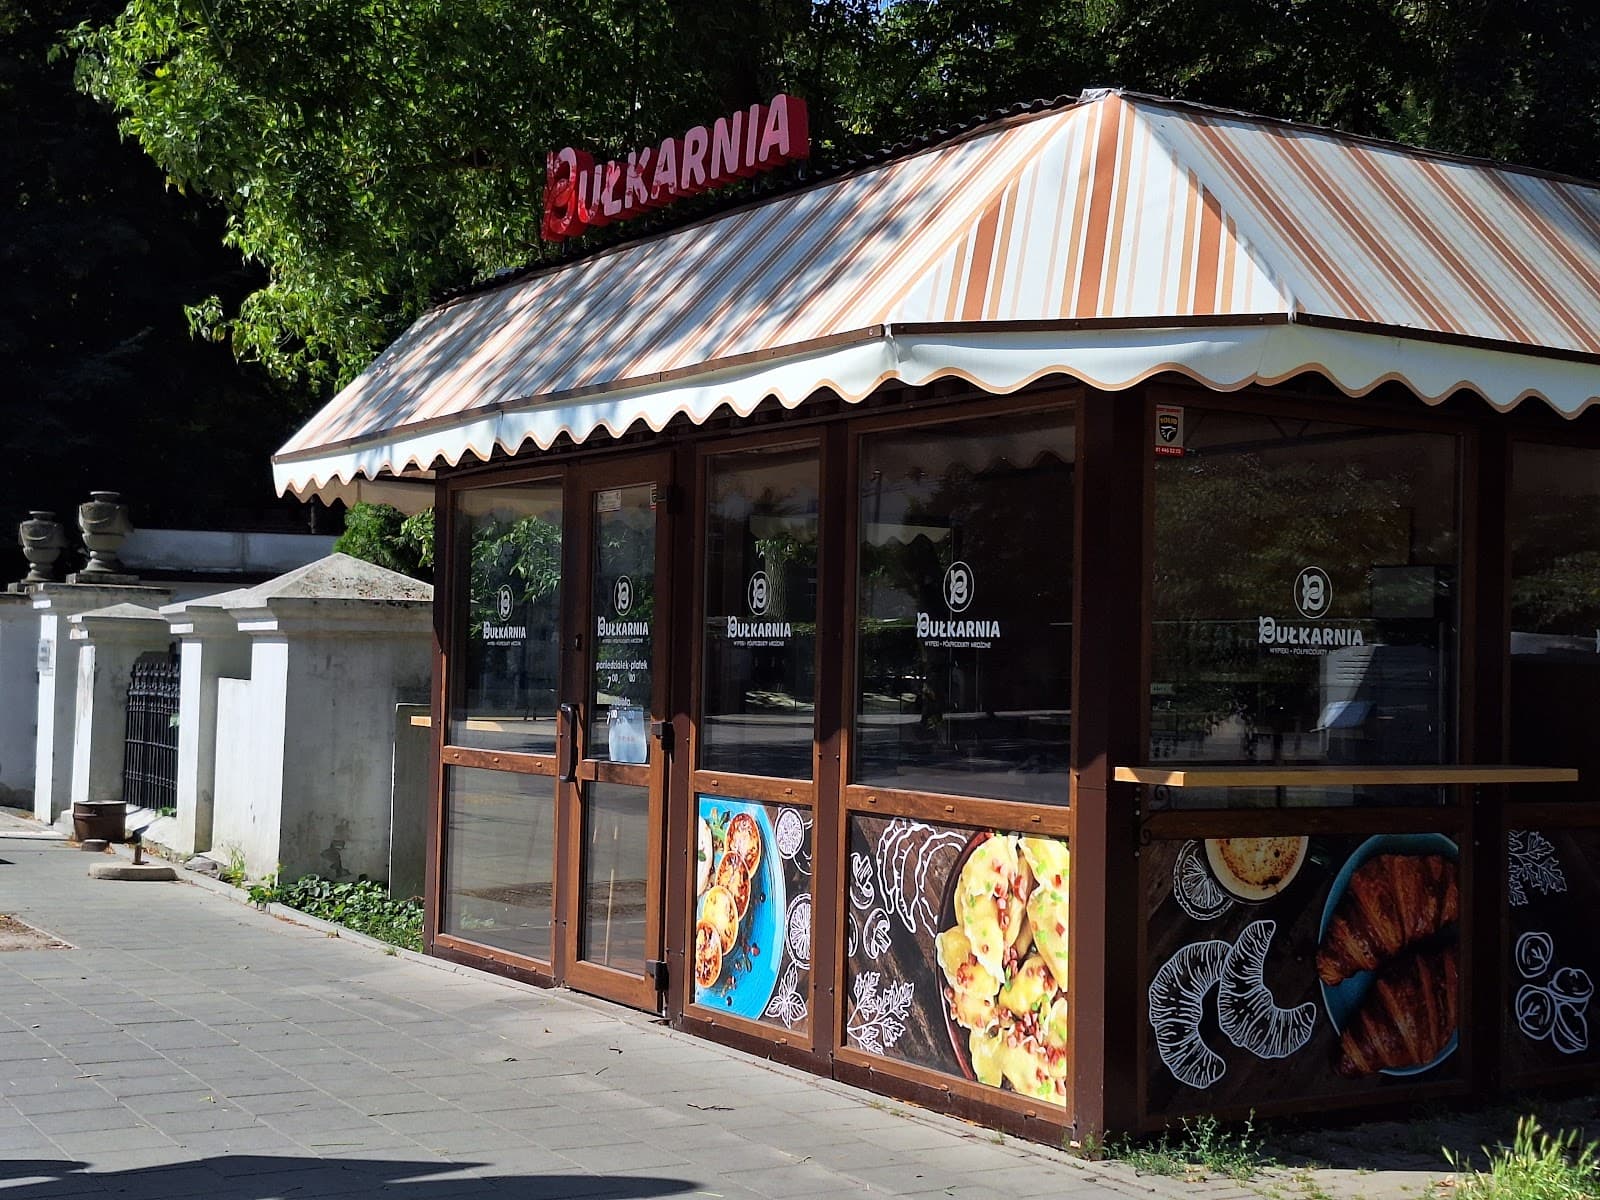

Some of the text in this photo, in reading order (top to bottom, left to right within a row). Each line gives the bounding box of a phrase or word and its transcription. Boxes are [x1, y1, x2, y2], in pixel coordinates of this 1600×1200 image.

[727, 615, 792, 639] BUŁKARNIA
[916, 612, 1001, 638] BUŁKARNIA
[1258, 615, 1364, 646] BUŁKARNIA
